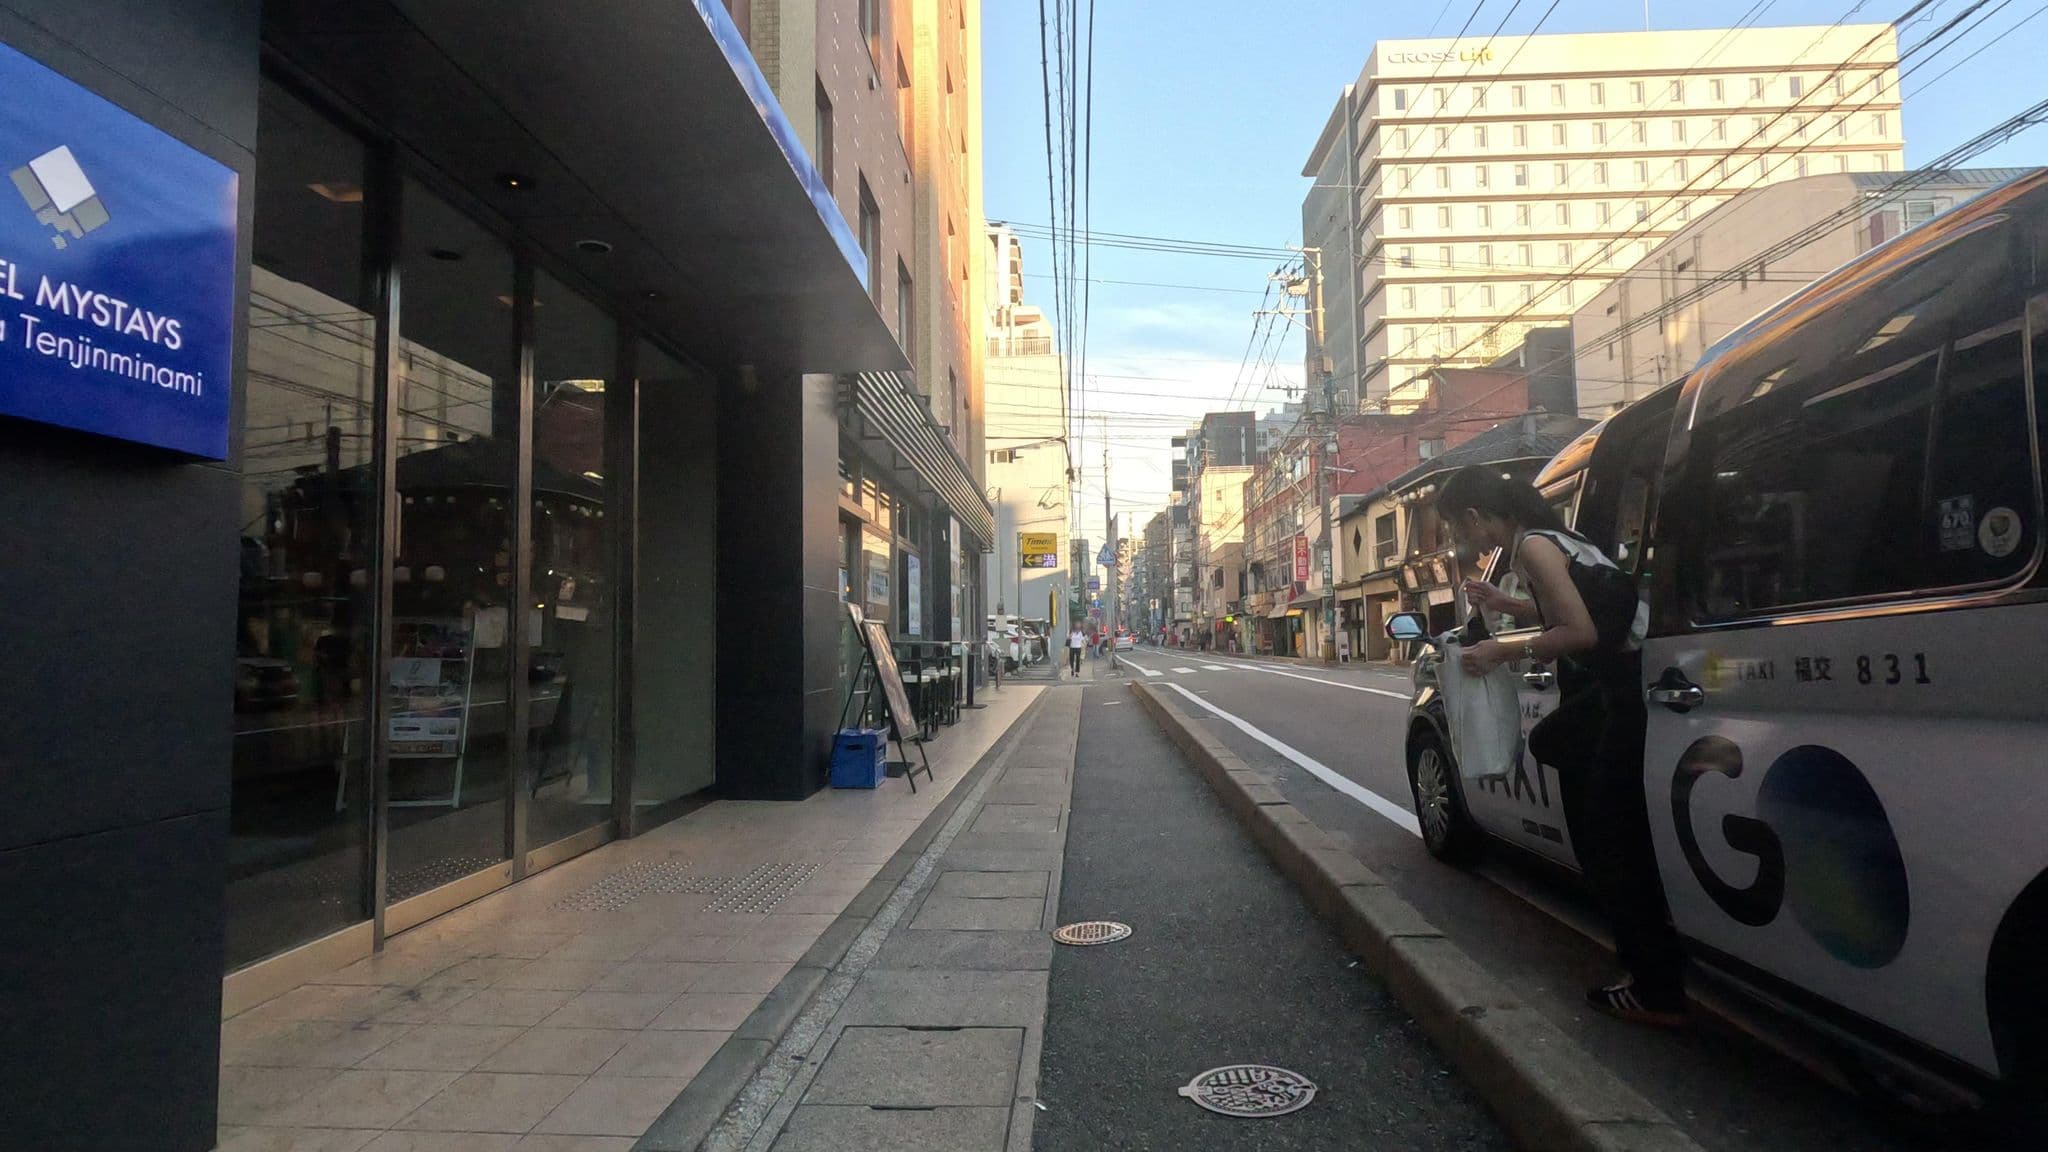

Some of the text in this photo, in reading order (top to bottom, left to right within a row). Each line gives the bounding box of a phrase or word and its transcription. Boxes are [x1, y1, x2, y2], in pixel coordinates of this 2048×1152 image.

[1388, 50, 1456, 64] CROSS
[35, 274, 182, 350] MYSTAYS
[19, 313, 203, 396] Tenjinminami
[1796, 656, 1832, 681] 福交
